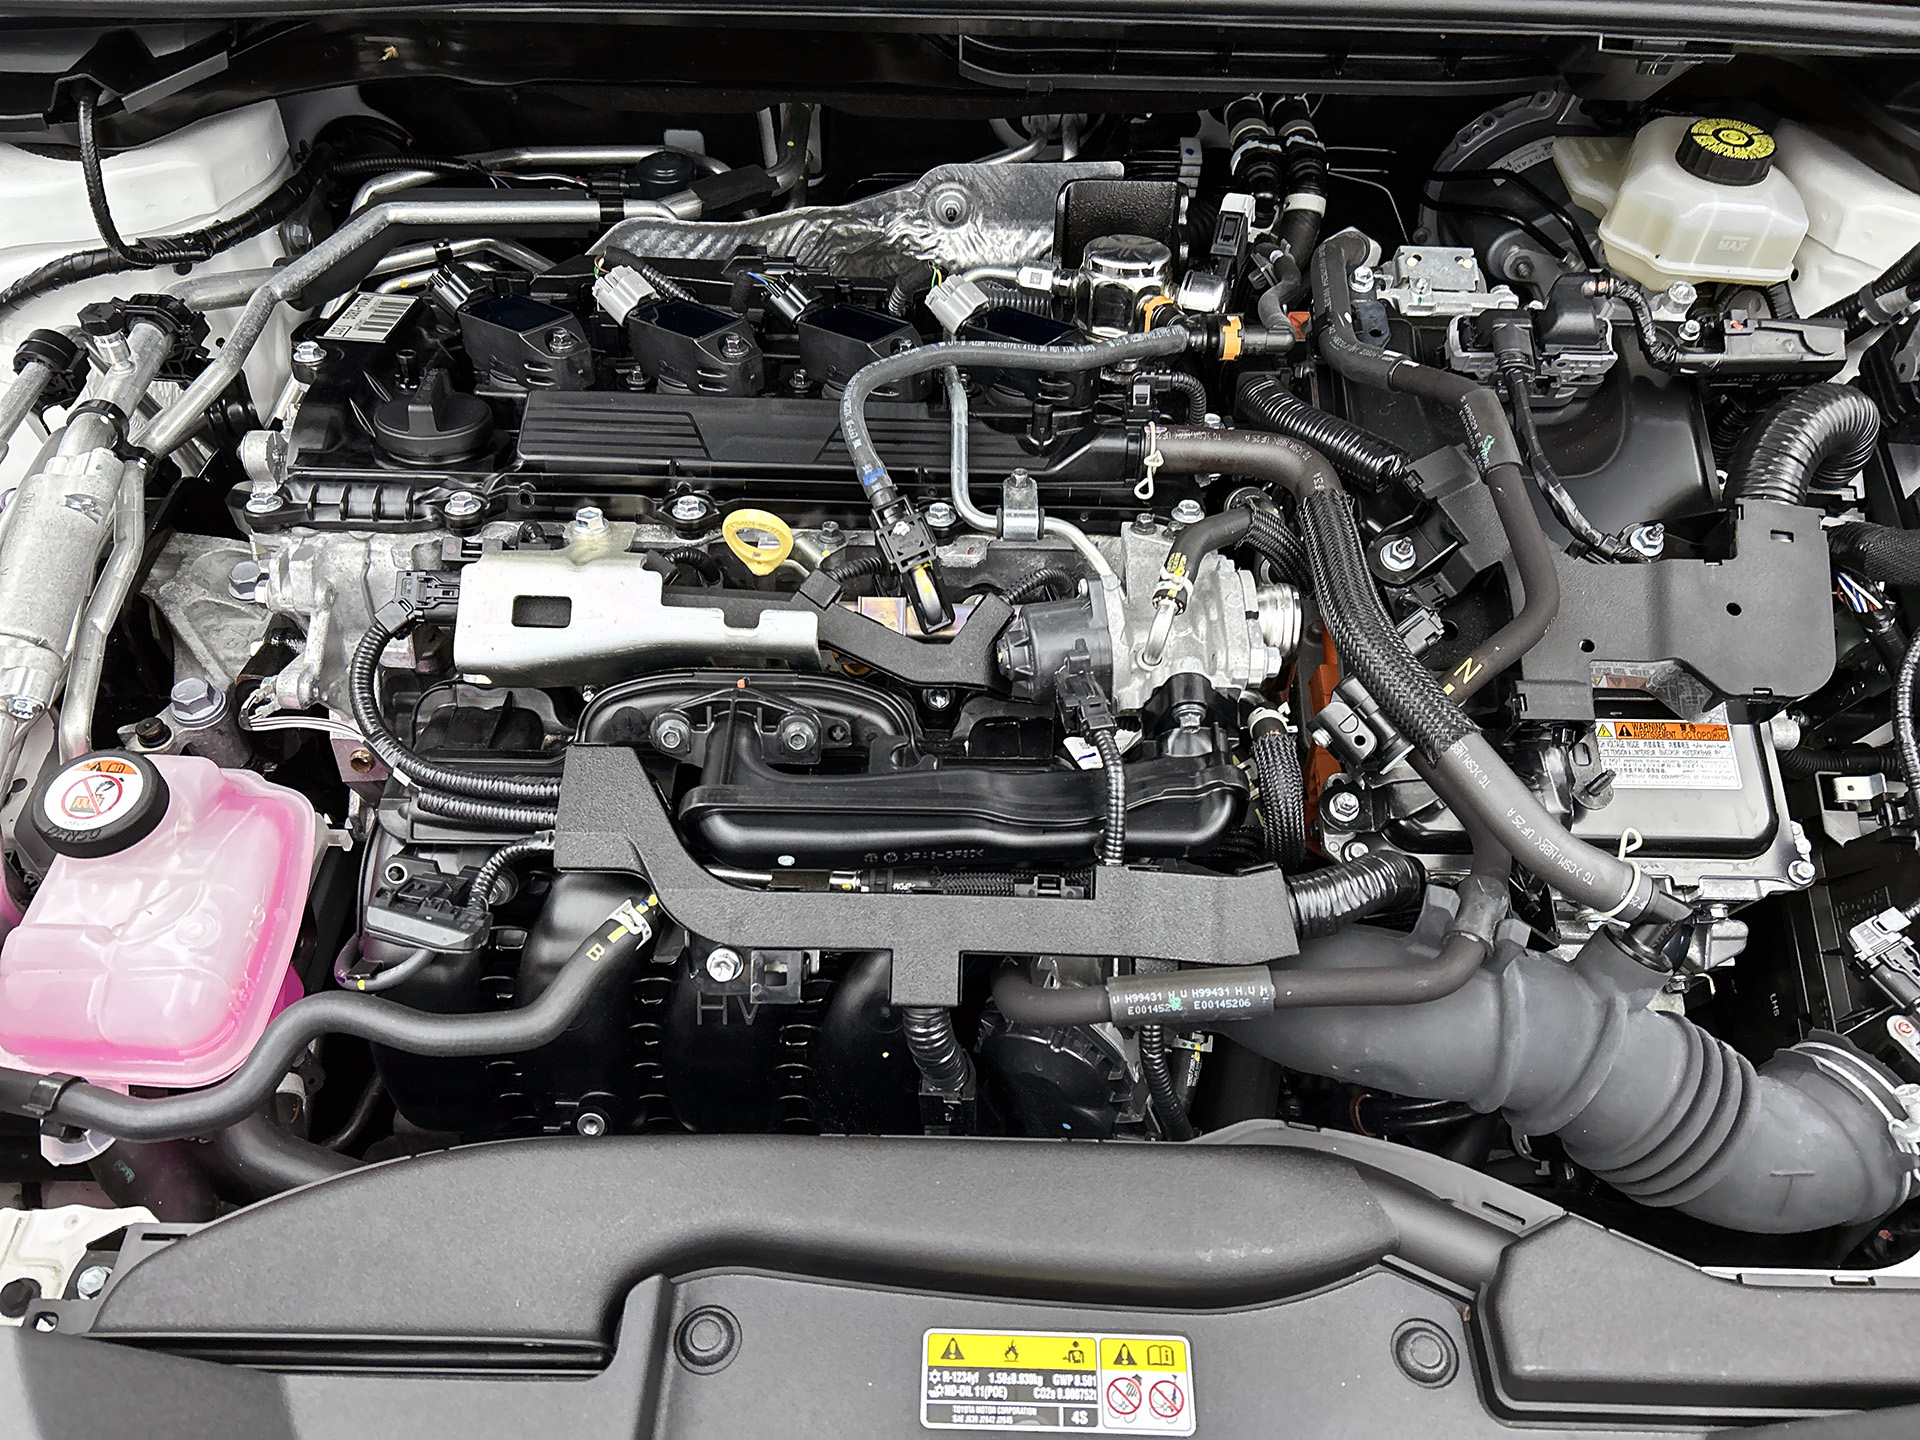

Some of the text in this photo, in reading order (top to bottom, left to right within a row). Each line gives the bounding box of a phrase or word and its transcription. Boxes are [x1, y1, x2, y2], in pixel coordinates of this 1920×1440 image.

[1717, 240, 1748, 251] MAX
[1632, 722, 1666, 732] WARNING
[1634, 730, 1677, 739] AVERTISSEMENT
[1449, 740, 1492, 790] TG >CSM,NBR
[1506, 807, 1516, 818] A
[1511, 815, 1527, 829] 25
[44, 826, 102, 843] DENSO
[1520, 824, 1536, 840] UF
[1582, 873, 1597, 887] TG
[586, 942, 606, 962] B
[1124, 992, 1163, 1005] H99431
[1191, 987, 1230, 999] H99431
[1193, 999, 1252, 1010] E00145206
[942, 1371, 980, 1386] R-1234yf
[1052, 1373, 1074, 1387] GWP
[944, 1384, 974, 1398] ND-OIL
[974, 1385, 1009, 1401] 11(POE)
[952, 1404, 1089, 1426] TOYOTA MOTOR CORPORATION 4S
[952, 1414, 964, 1423] SAE
